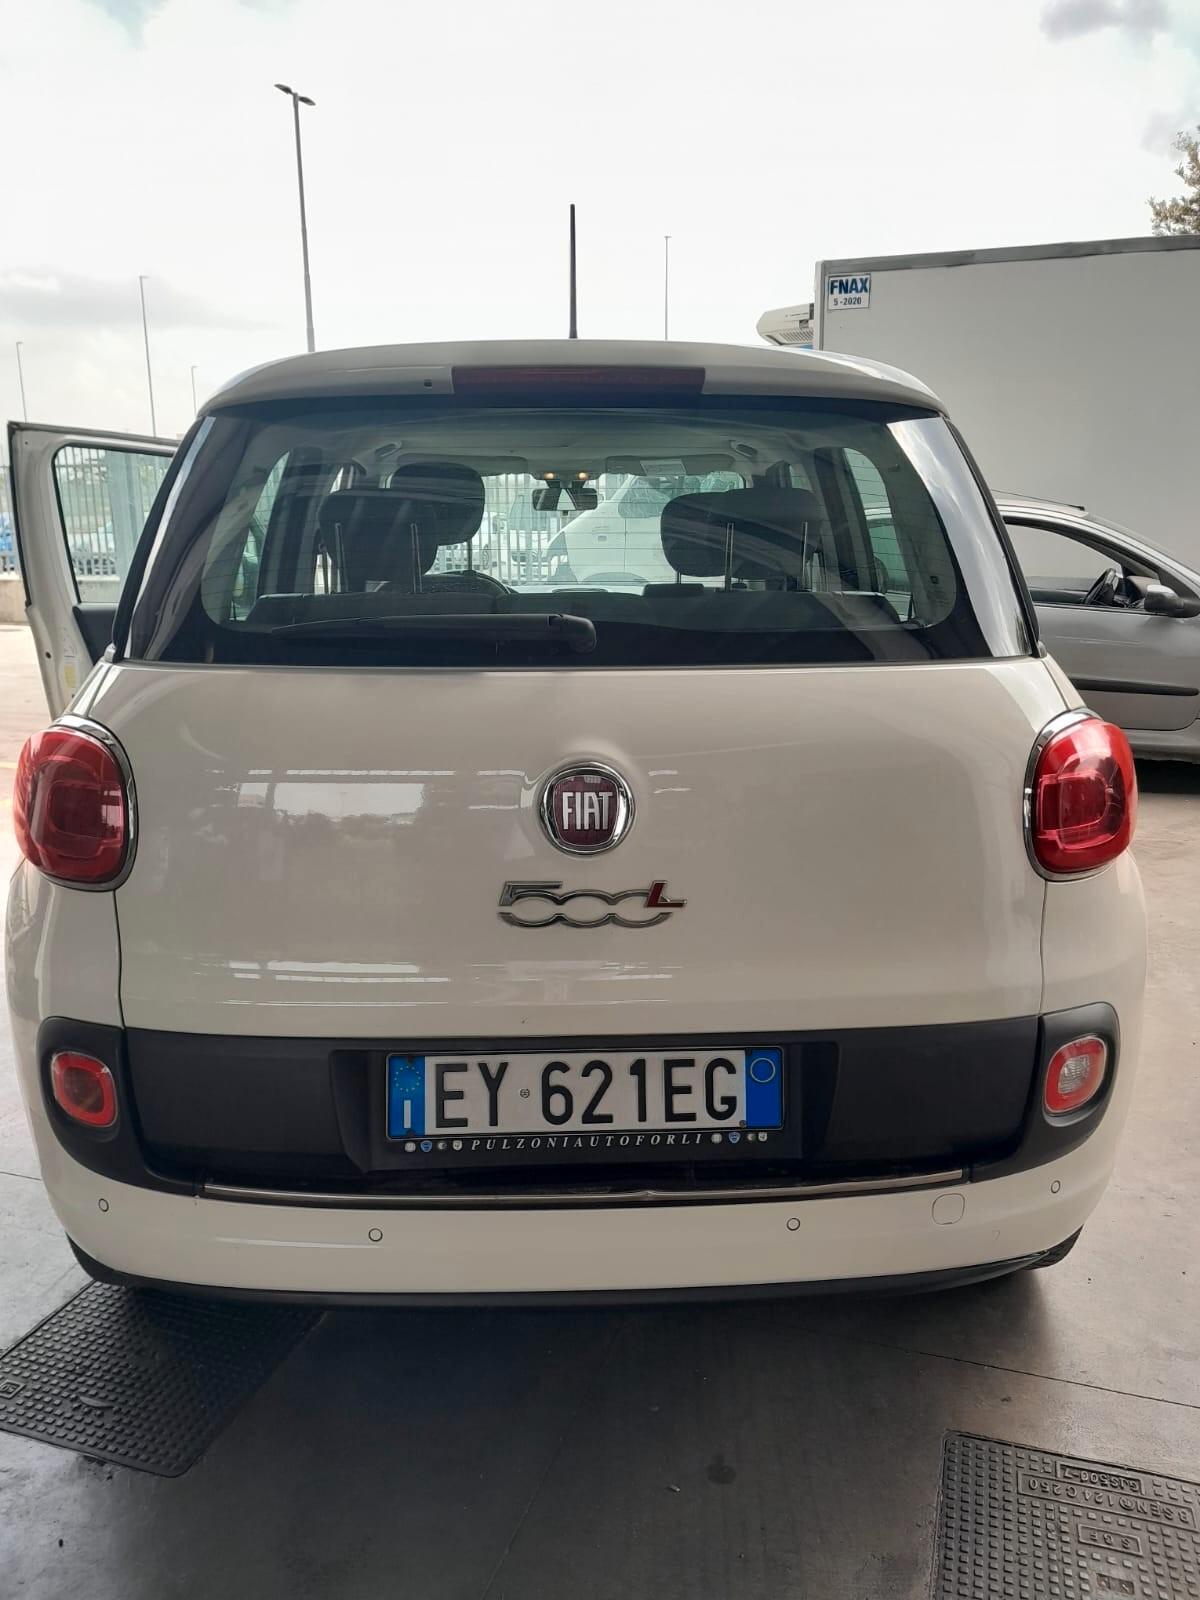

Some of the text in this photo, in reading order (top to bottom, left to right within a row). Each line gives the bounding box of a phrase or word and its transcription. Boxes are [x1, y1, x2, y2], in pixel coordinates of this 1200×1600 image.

[830, 277, 868, 295] FNAX
[561, 791, 613, 830] FIAT
[435, 1057, 738, 1128] EY 621EG
